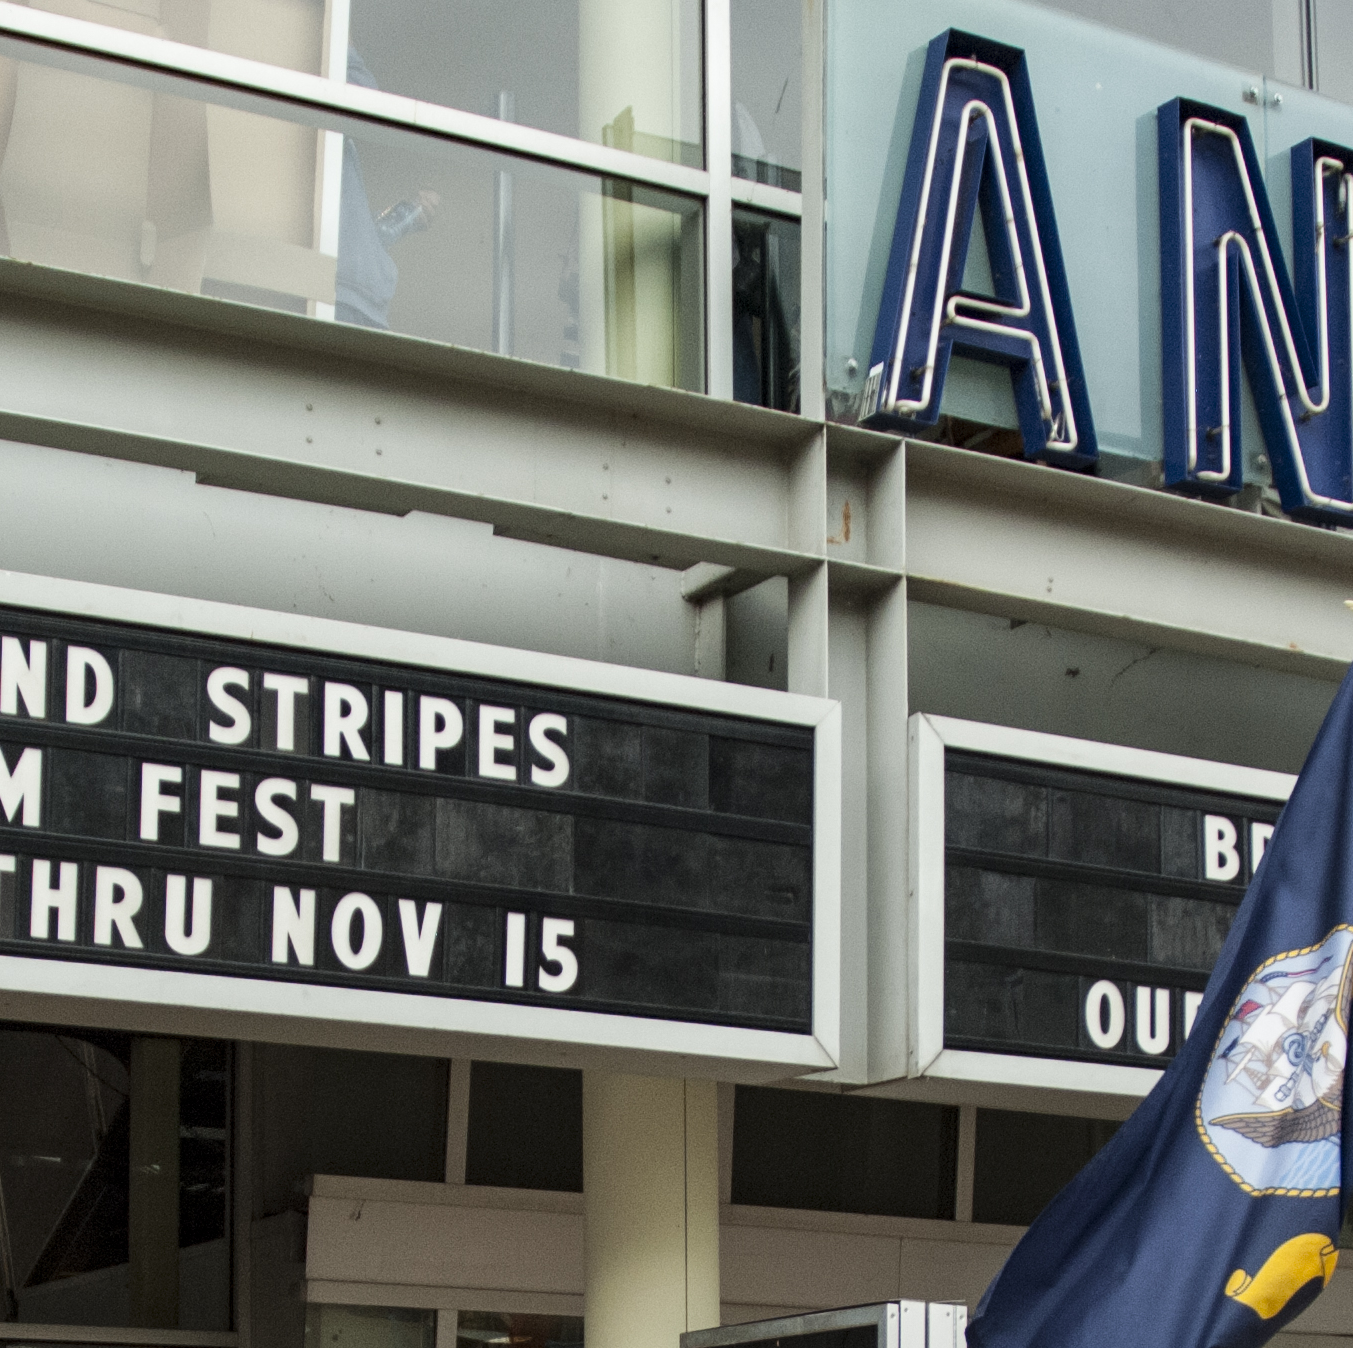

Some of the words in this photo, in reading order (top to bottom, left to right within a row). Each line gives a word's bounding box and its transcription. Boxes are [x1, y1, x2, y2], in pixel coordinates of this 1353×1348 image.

[207, 667, 569, 787] STRIPES
[141, 763, 354, 862] FEST
[272, 887, 442, 976] NOV
[506, 913, 577, 992] 15
